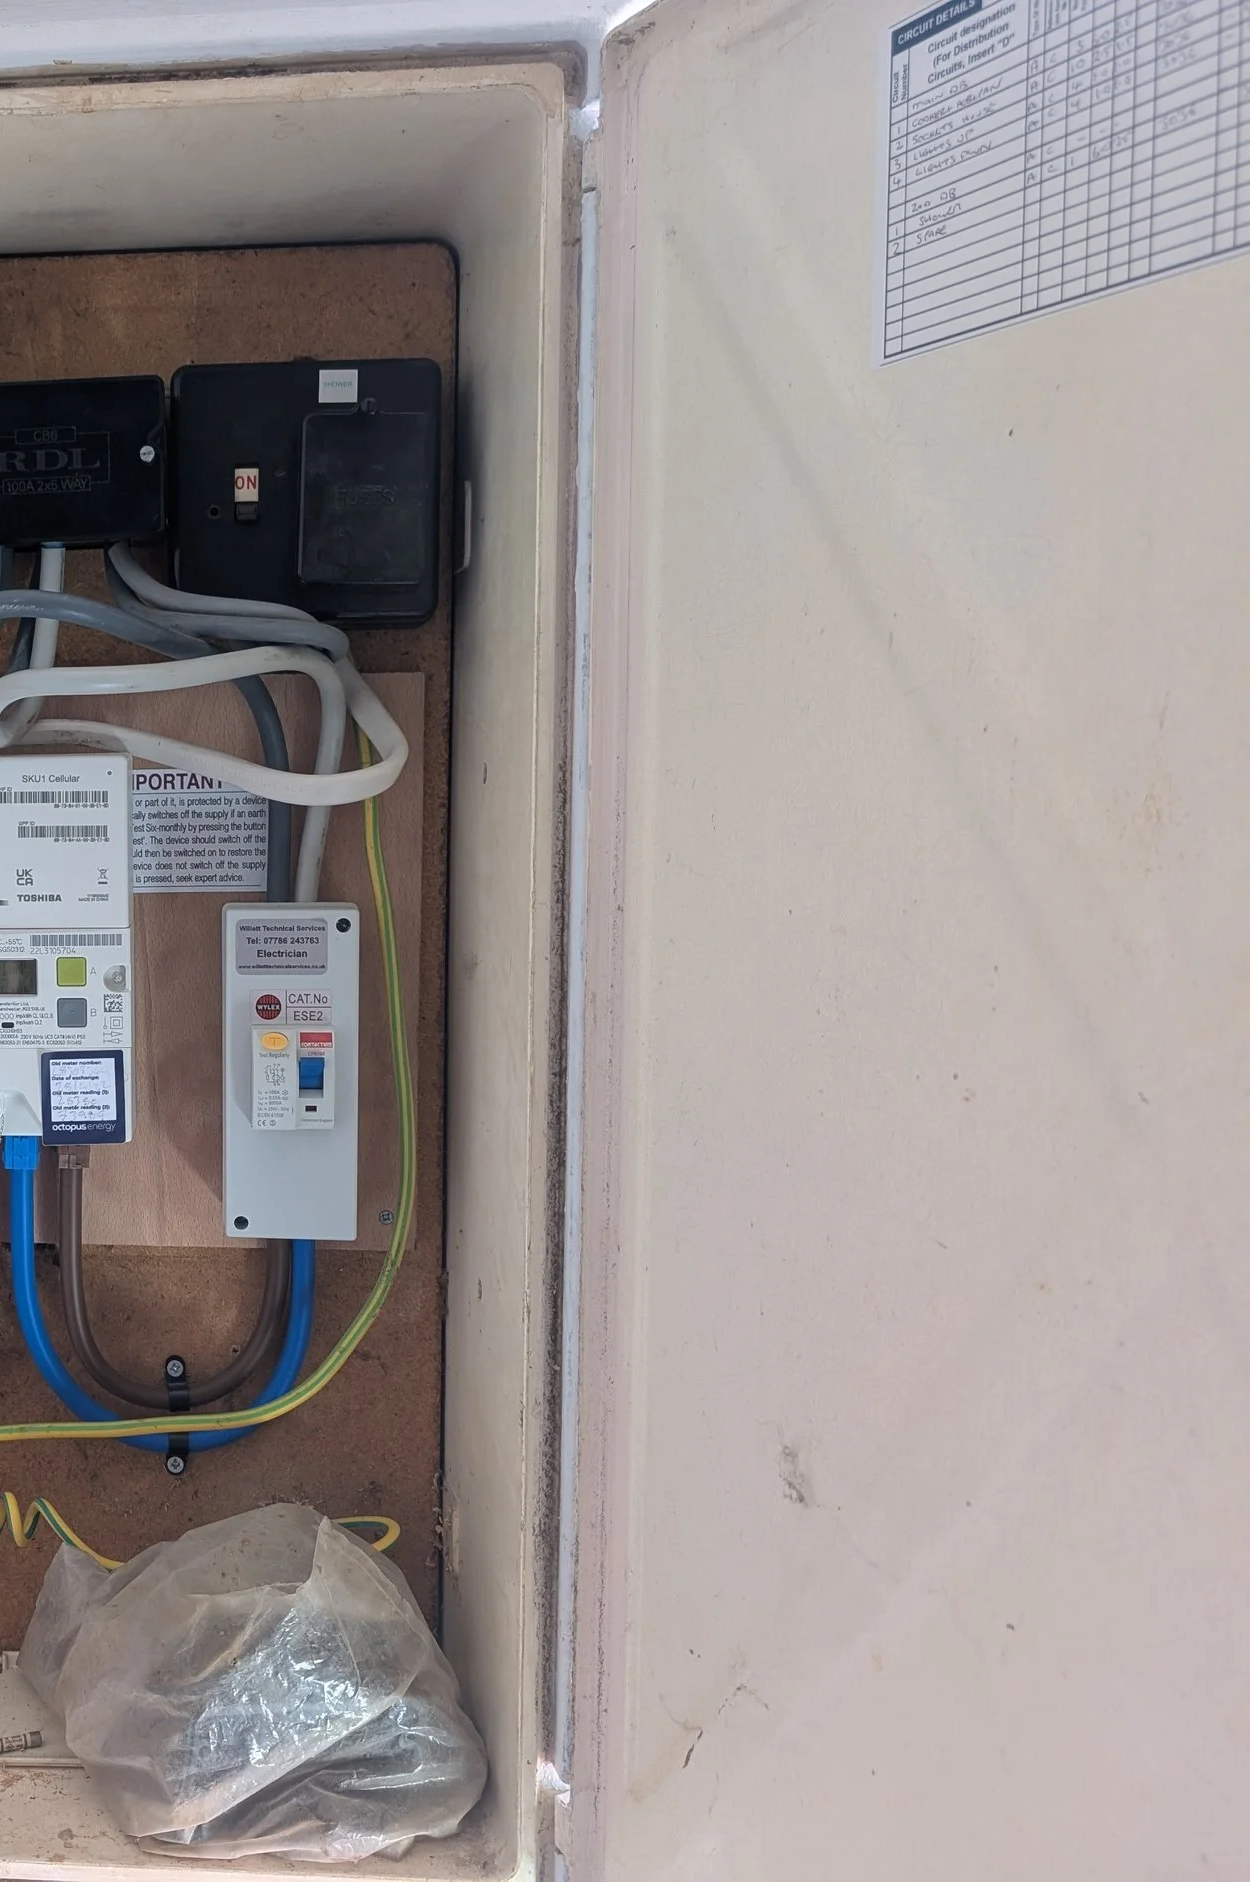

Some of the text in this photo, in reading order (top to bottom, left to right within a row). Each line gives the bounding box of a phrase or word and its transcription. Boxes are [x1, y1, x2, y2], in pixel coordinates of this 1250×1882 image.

[898, 0, 974, 44] CIRCUIT DETAILS
[928, 32, 958, 53] Circuit
[960, 3, 1016, 37] designation
[933, 23, 1009, 68] (For Distribution
[928, 44, 994, 84] Circuits, Insert
[7, 481, 34, 492] 100A
[61, 478, 87, 490] WAY
[235, 476, 257, 490] ON
[22, 774, 80, 783] SKU1 Cellular
[133, 773, 222, 790] PORTAN
[145, 798, 159, 808] part
[161, 797, 168, 806] of
[179, 797, 185, 806] is
[187, 797, 221, 808] protected
[224, 797, 232, 807] by
[242, 796, 266, 805] device
[148, 810, 178, 819] switches
[181, 810, 190, 818] off
[192, 810, 202, 818] the
[205, 810, 228, 821] supply
[231, 809, 235, 818] if
[248, 809, 266, 817] earth
[146, 822, 266, 833] Six-monthly by pressing the button
[150, 834, 266, 845] The device should switch off the
[145, 849, 160, 858] then
[162, 849, 172, 857] be
[174, 848, 205, 857] switched
[255, 848, 266, 856] the
[155, 861, 172, 870] does
[190, 861, 212, 869] switch
[216, 861, 225, 869] off
[228, 860, 239, 869] the
[242, 861, 266, 871] supply
[17, 869, 33, 877] UK
[136, 873, 244, 884] is pressed, seek expert advice.
[17, 878, 33, 886] CA
[17, 894, 62, 902] TOSHIBA
[289, 994, 328, 1004] CAT.No
[90, 1008, 96, 1016] B
[294, 1011, 323, 1021] ESE2
[52, 1123, 116, 1132] octopus energy
